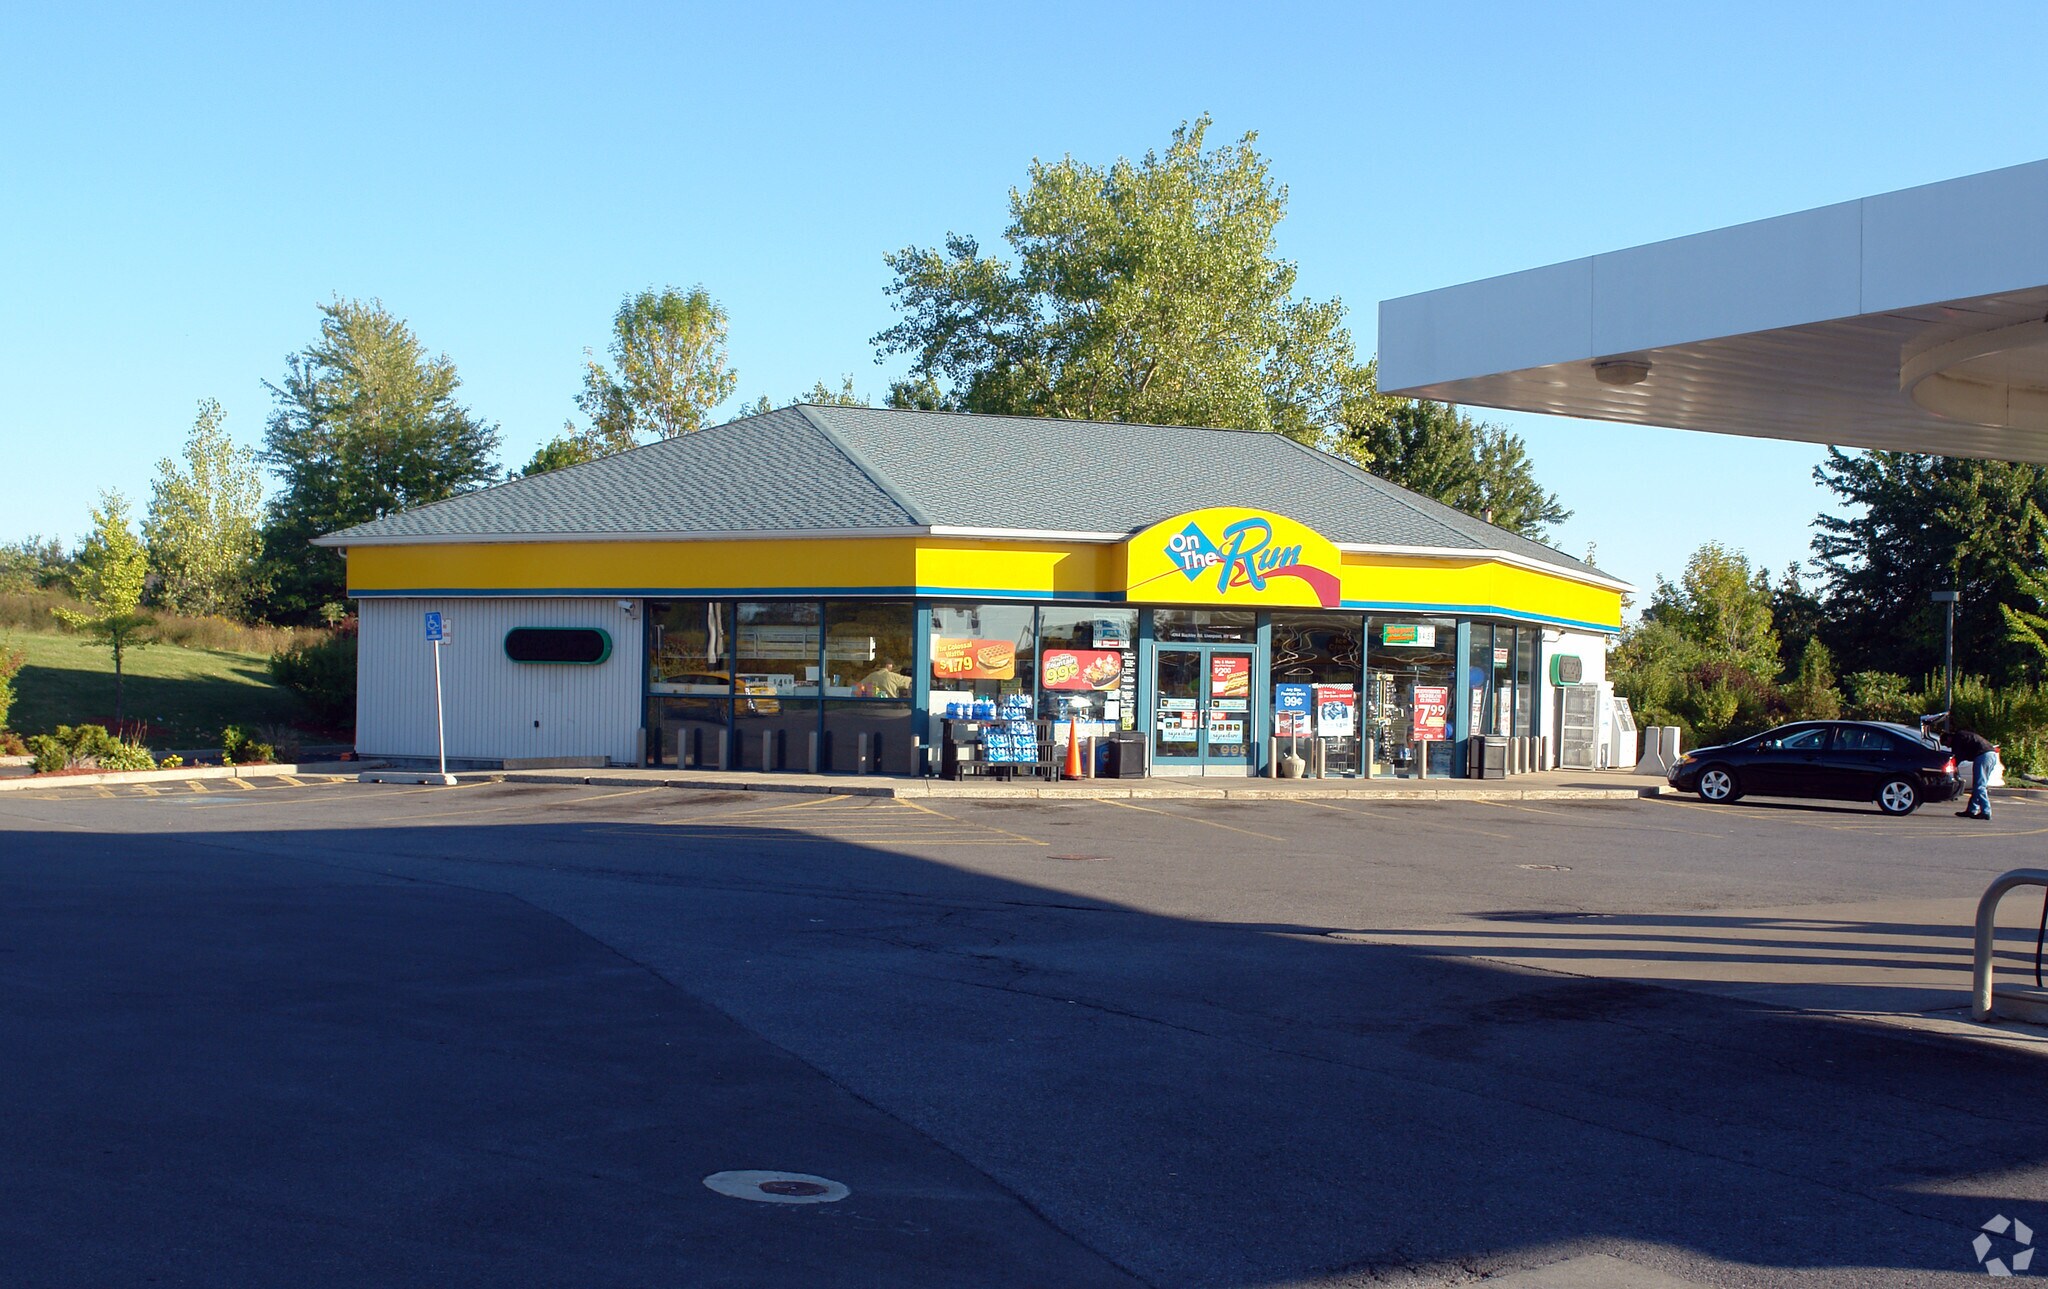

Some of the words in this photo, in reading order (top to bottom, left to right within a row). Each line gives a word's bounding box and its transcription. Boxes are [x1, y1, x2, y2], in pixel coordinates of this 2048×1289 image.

[1169, 533, 1200, 552] On
[1180, 551, 1218, 570] The
[1217, 517, 1303, 594] Run
[945, 650, 965, 658] Waffle
[947, 641, 973, 651] Colossal
[940, 656, 973, 673] $1.79
[1283, 696, 1303, 707] 99¢
